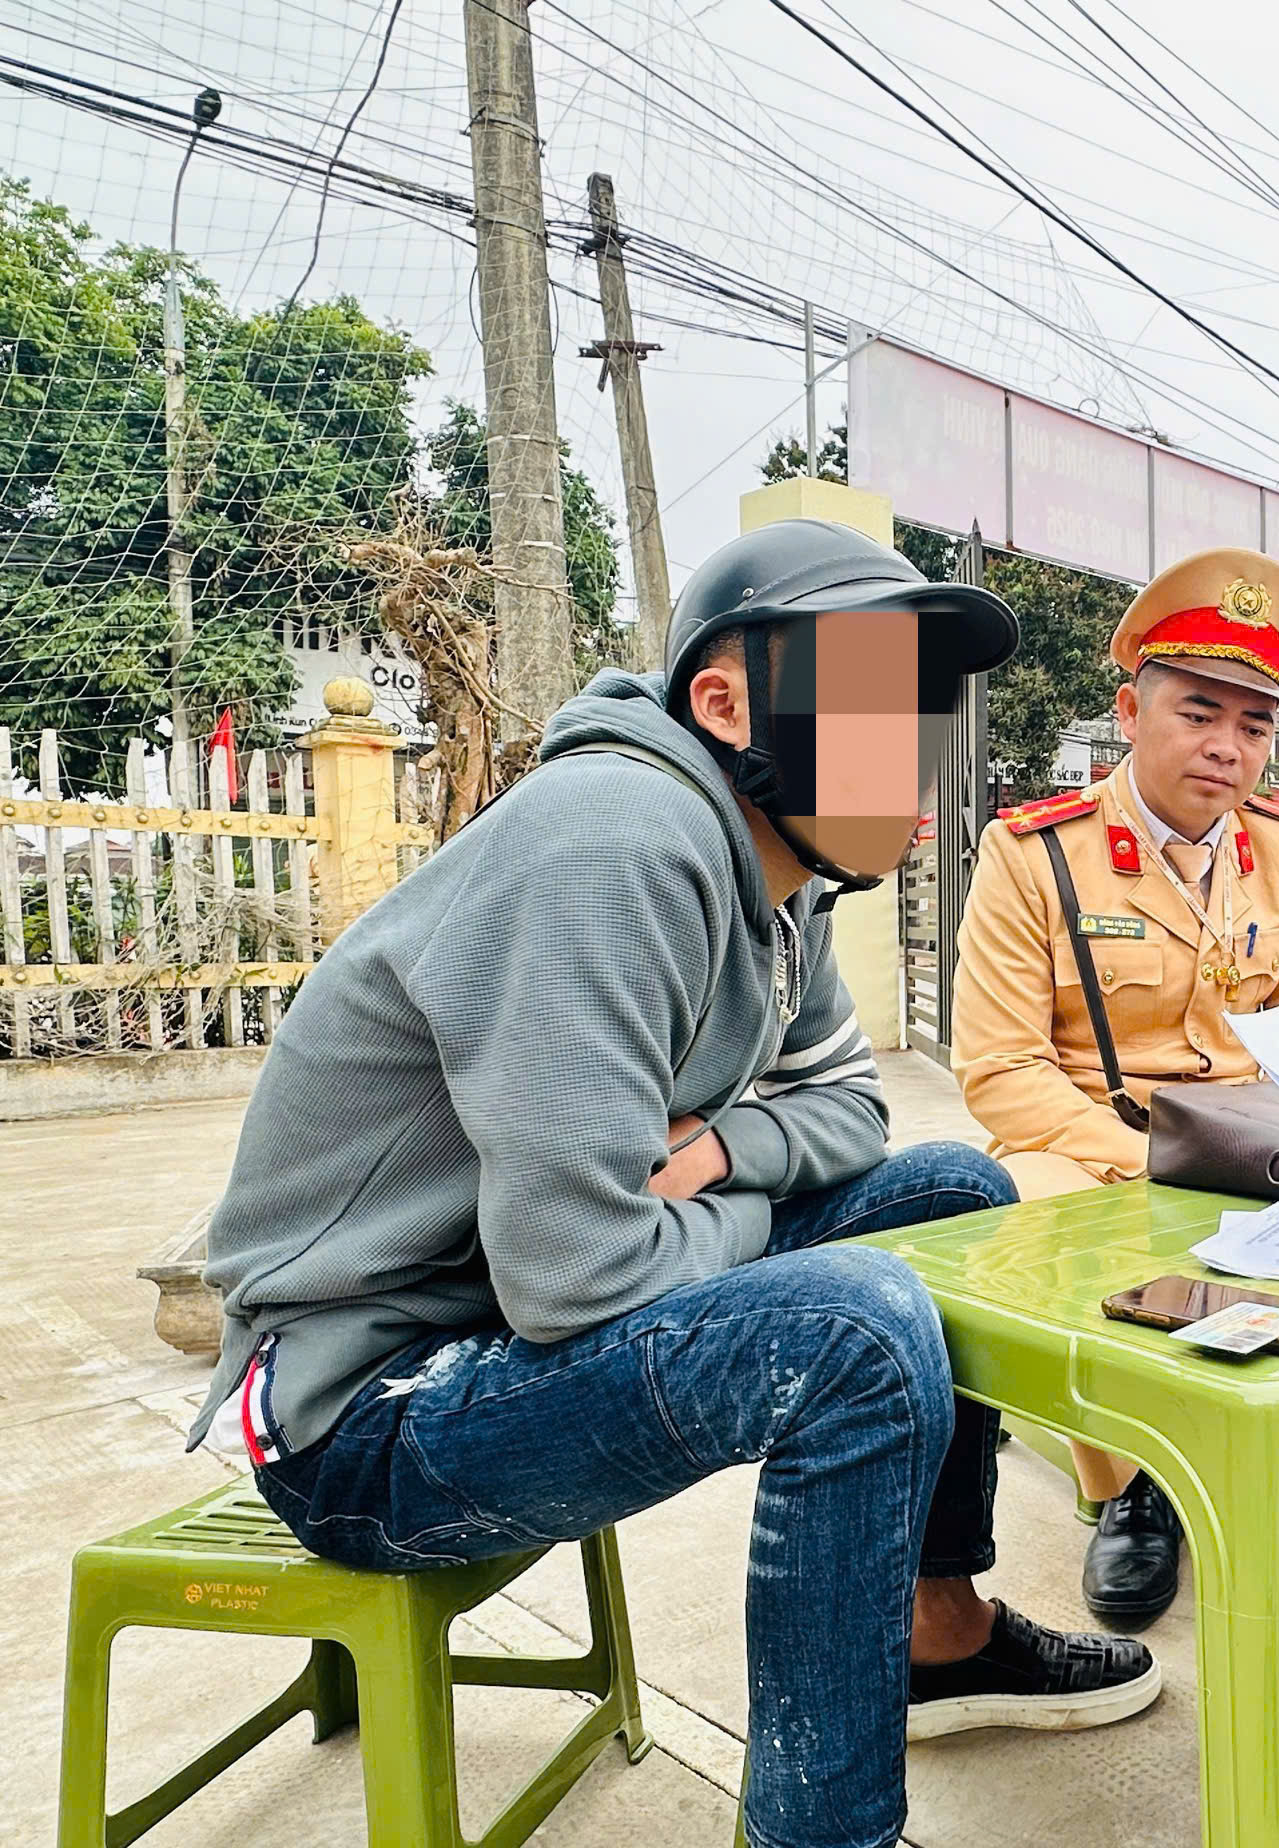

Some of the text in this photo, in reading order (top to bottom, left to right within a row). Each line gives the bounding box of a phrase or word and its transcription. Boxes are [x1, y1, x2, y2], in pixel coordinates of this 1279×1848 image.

[371, 666, 416, 690] Clo
[203, 1582, 269, 1597] VIET NHAT
[210, 1598, 258, 1610] PLASTIC
